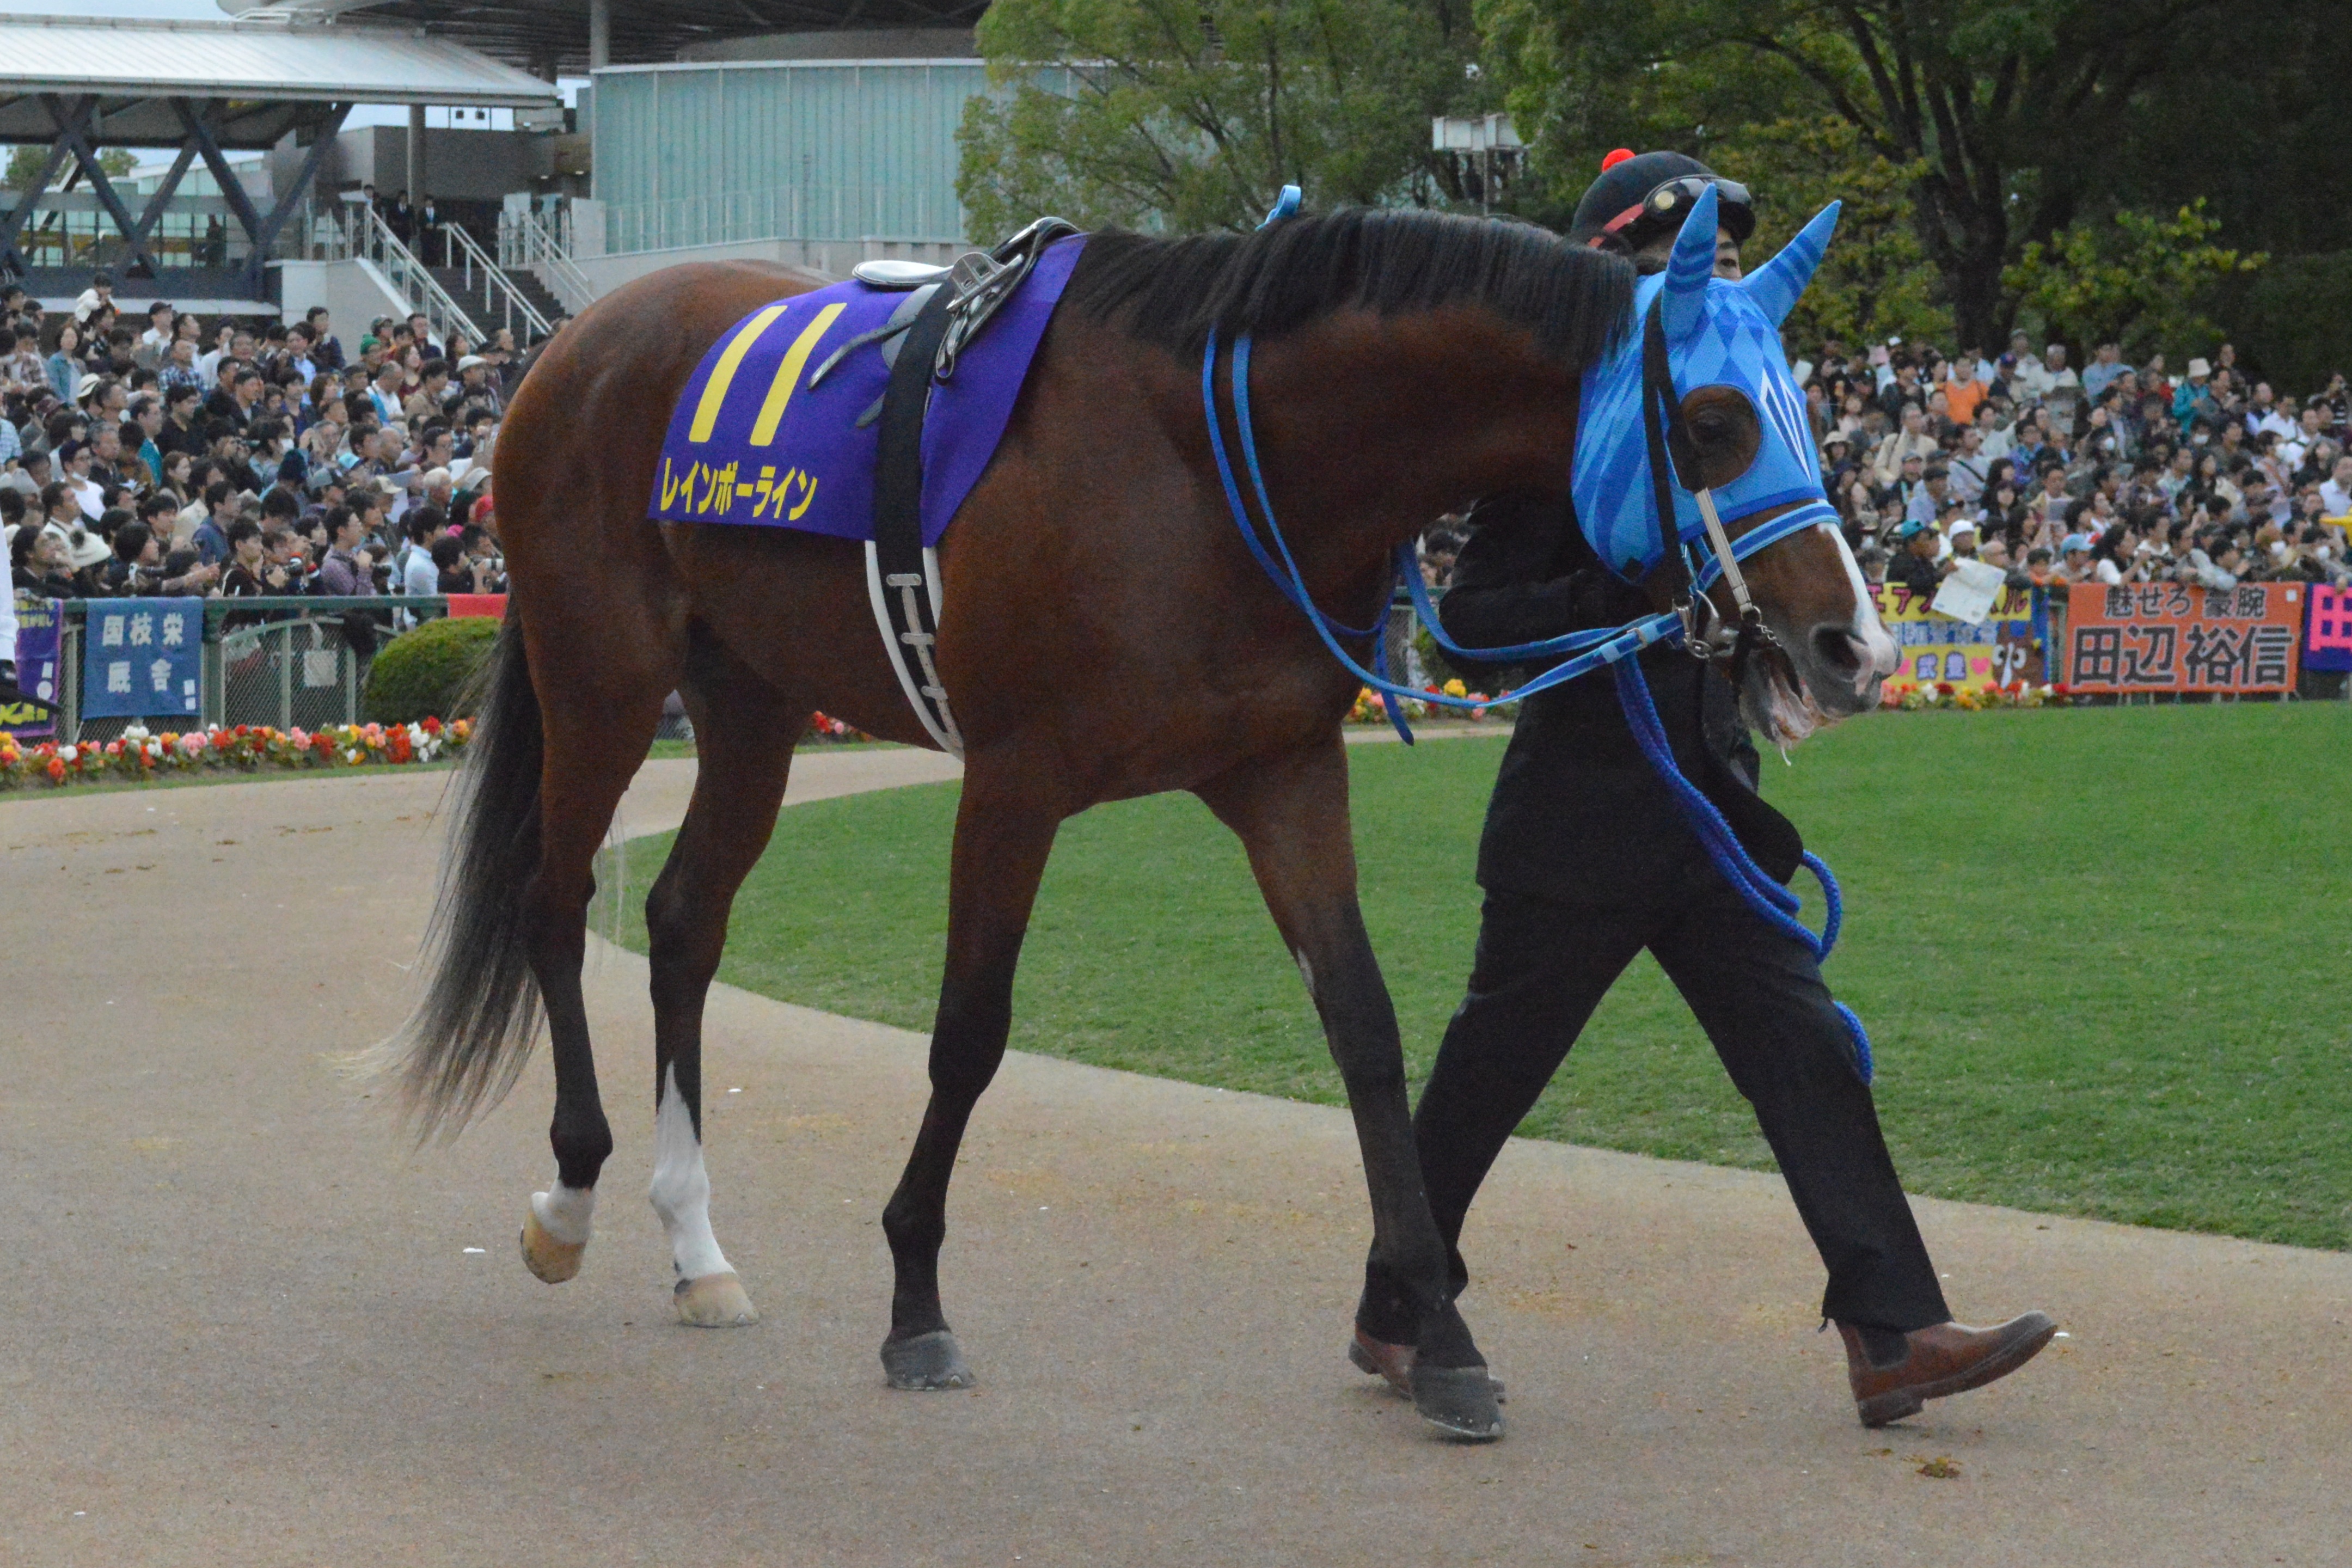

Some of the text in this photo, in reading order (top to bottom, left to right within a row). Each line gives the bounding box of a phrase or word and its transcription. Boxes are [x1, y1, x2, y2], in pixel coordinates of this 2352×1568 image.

[688, 302, 847, 446] 11
[660, 457, 818, 521] レインボーライン
